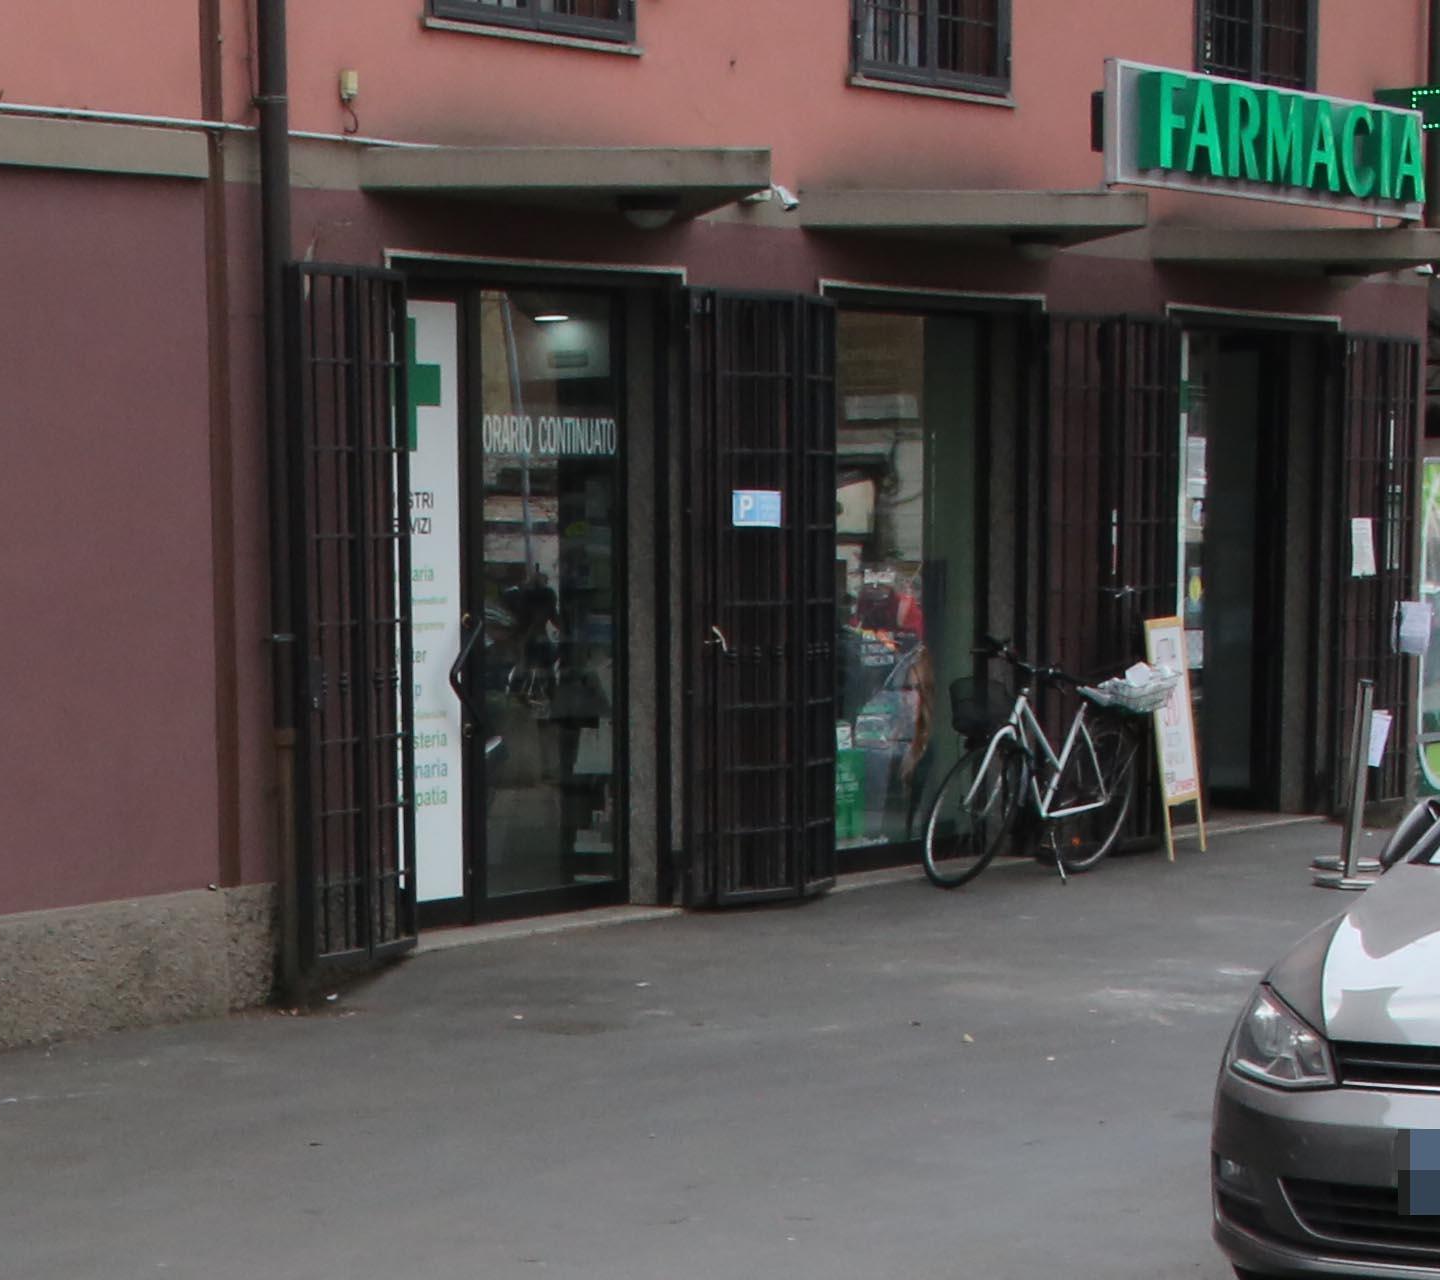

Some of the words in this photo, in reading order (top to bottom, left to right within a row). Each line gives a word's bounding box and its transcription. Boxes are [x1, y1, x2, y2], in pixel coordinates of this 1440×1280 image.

[1139, 71, 1425, 202] FARMACIA
[482, 414, 533, 453] ORARIO
[538, 415, 617, 455] CONTINUATO
